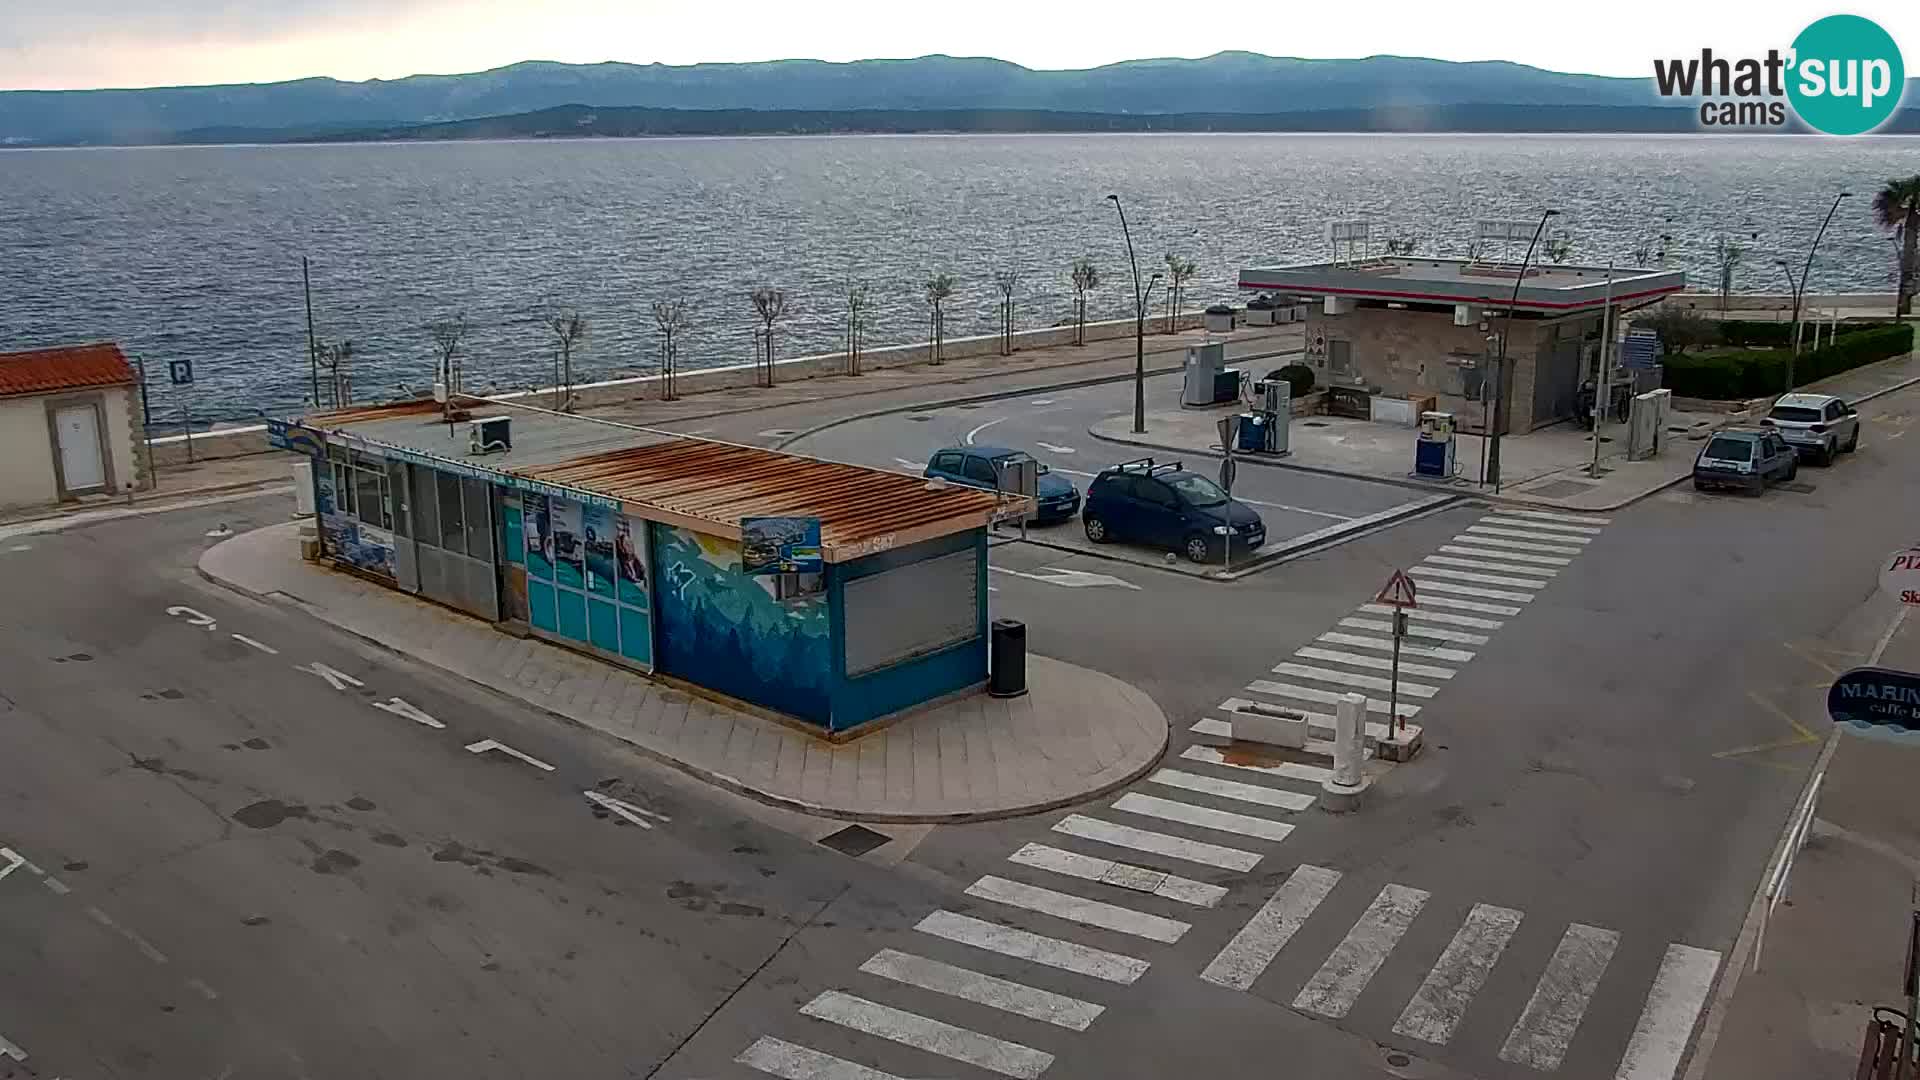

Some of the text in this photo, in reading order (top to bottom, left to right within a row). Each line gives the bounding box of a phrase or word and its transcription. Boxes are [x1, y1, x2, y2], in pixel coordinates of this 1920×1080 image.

[175, 363, 187, 381] P
[532, 482, 564, 498] STATION
[566, 487, 591, 504] TICKET
[592, 495, 618, 510] OFFICE
[1869, 703, 1908, 718] caffe
